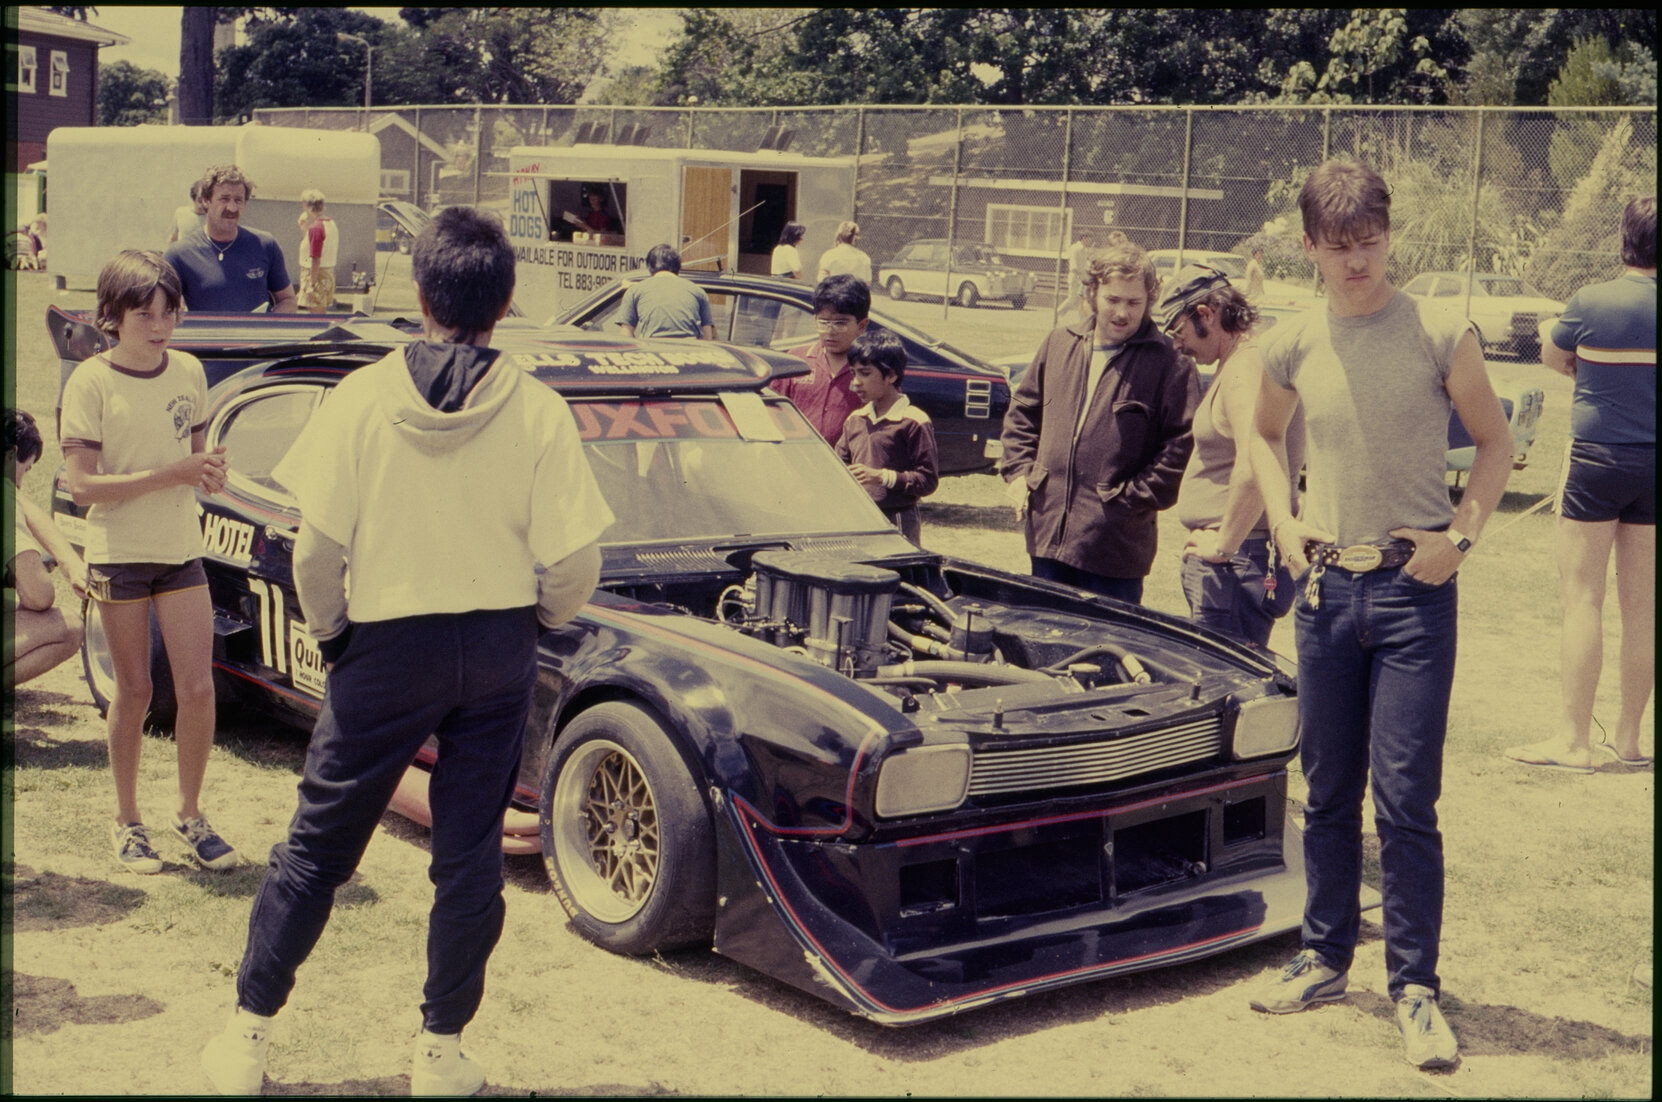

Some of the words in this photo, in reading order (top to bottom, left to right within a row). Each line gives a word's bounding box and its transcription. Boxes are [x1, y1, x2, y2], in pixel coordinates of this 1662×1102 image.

[513, 189, 537, 213] HOT
[510, 214, 542, 239] DOGS
[557, 250, 574, 268] FOR
[576, 252, 617, 272] OUTDOOR
[619, 255, 646, 273] FUNC
[558, 271, 574, 290] TEL
[511, 351, 581, 372] ELLS
[202, 512, 256, 561] HOTEL
[545, 856, 579, 918] DUNLOP
